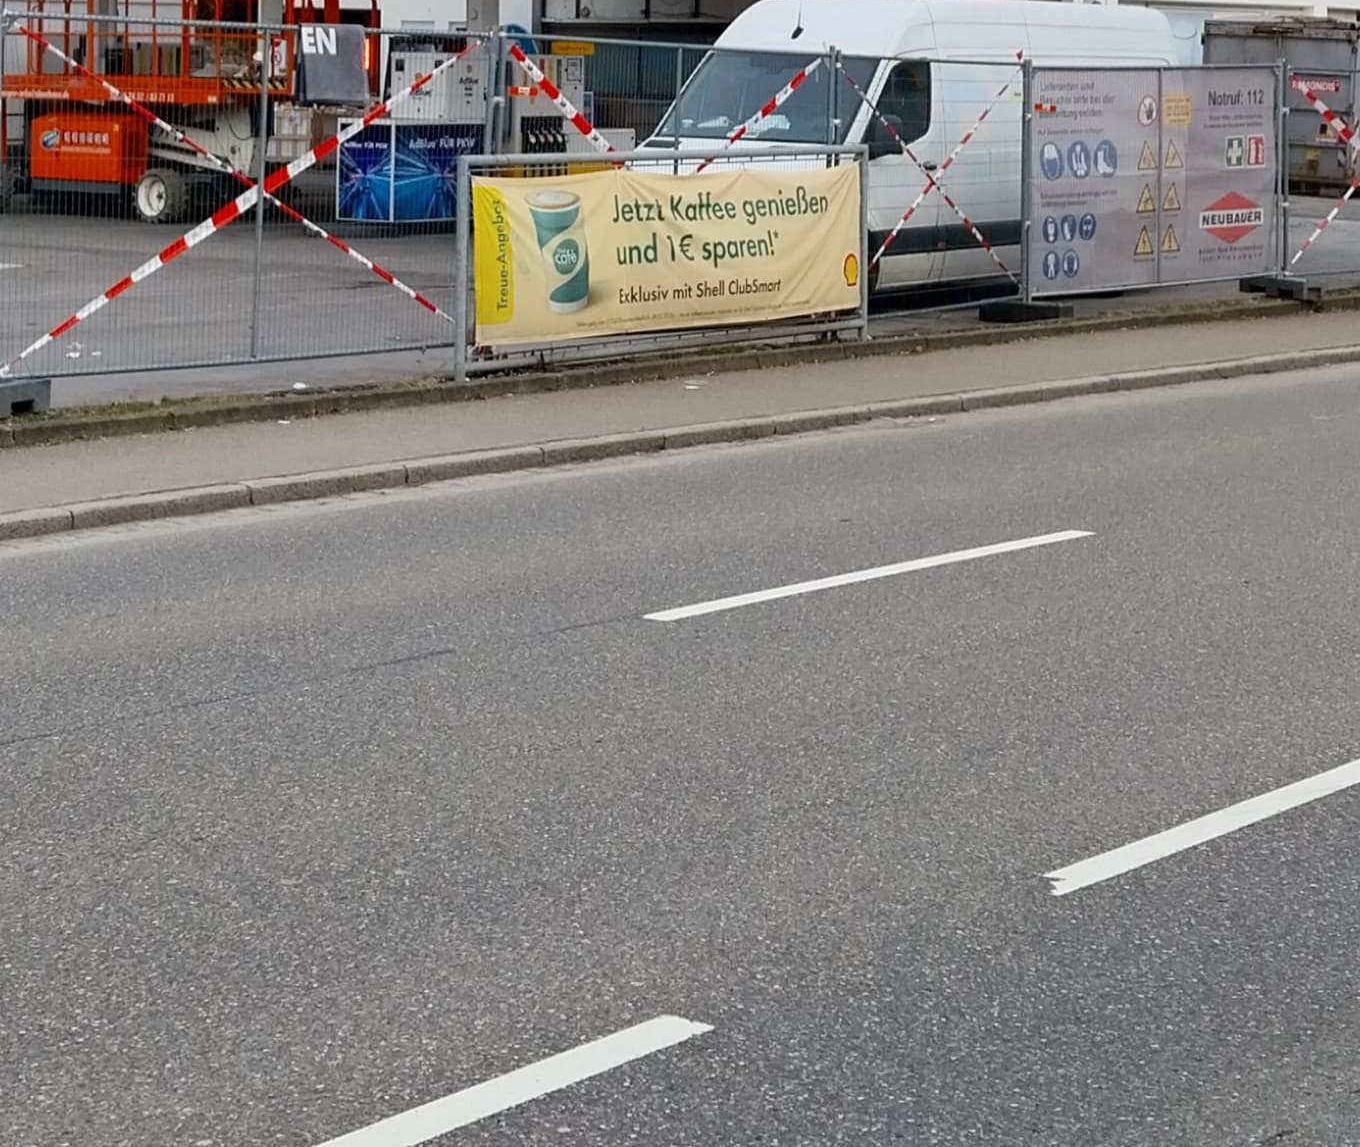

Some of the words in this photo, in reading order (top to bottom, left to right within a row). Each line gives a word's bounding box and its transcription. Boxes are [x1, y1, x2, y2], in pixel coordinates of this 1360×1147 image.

[301, 26, 338, 56] EN
[1207, 90, 1244, 107] Notruf:
[1247, 90, 1265, 106] 112
[440, 136, 455, 149] FÜR
[457, 137, 476, 149] PKW
[613, 194, 665, 223] Jetzt
[671, 191, 738, 222] Kaffee
[743, 185, 829, 226] genießen
[1202, 211, 1262, 227] NEUBAUER
[492, 198, 510, 312] Treue-Angebot
[617, 232, 658, 265] und
[619, 285, 669, 304] Exklusiv
[673, 285, 693, 301] mit
[696, 279, 725, 298] Shell
[728, 278, 782, 296] ClubSmart
